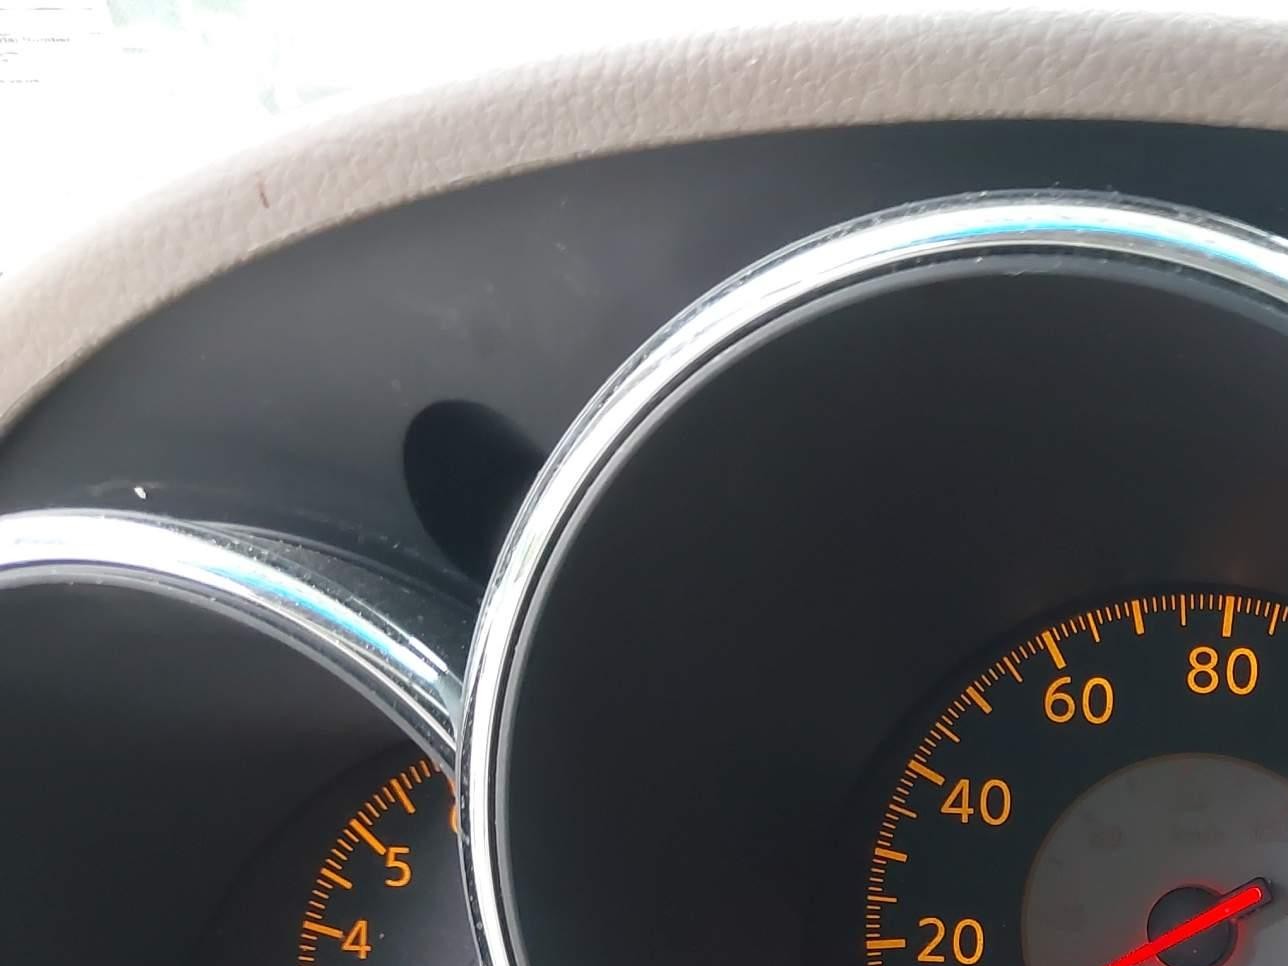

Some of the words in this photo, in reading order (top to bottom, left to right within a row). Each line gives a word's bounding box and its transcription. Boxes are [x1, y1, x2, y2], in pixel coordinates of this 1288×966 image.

[1187, 647, 1258, 695] 80
[1044, 676, 1114, 724] 60
[940, 779, 1012, 826] 40
[383, 847, 411, 887] 5
[341, 919, 371, 960] 4
[917, 917, 984, 965] 20
